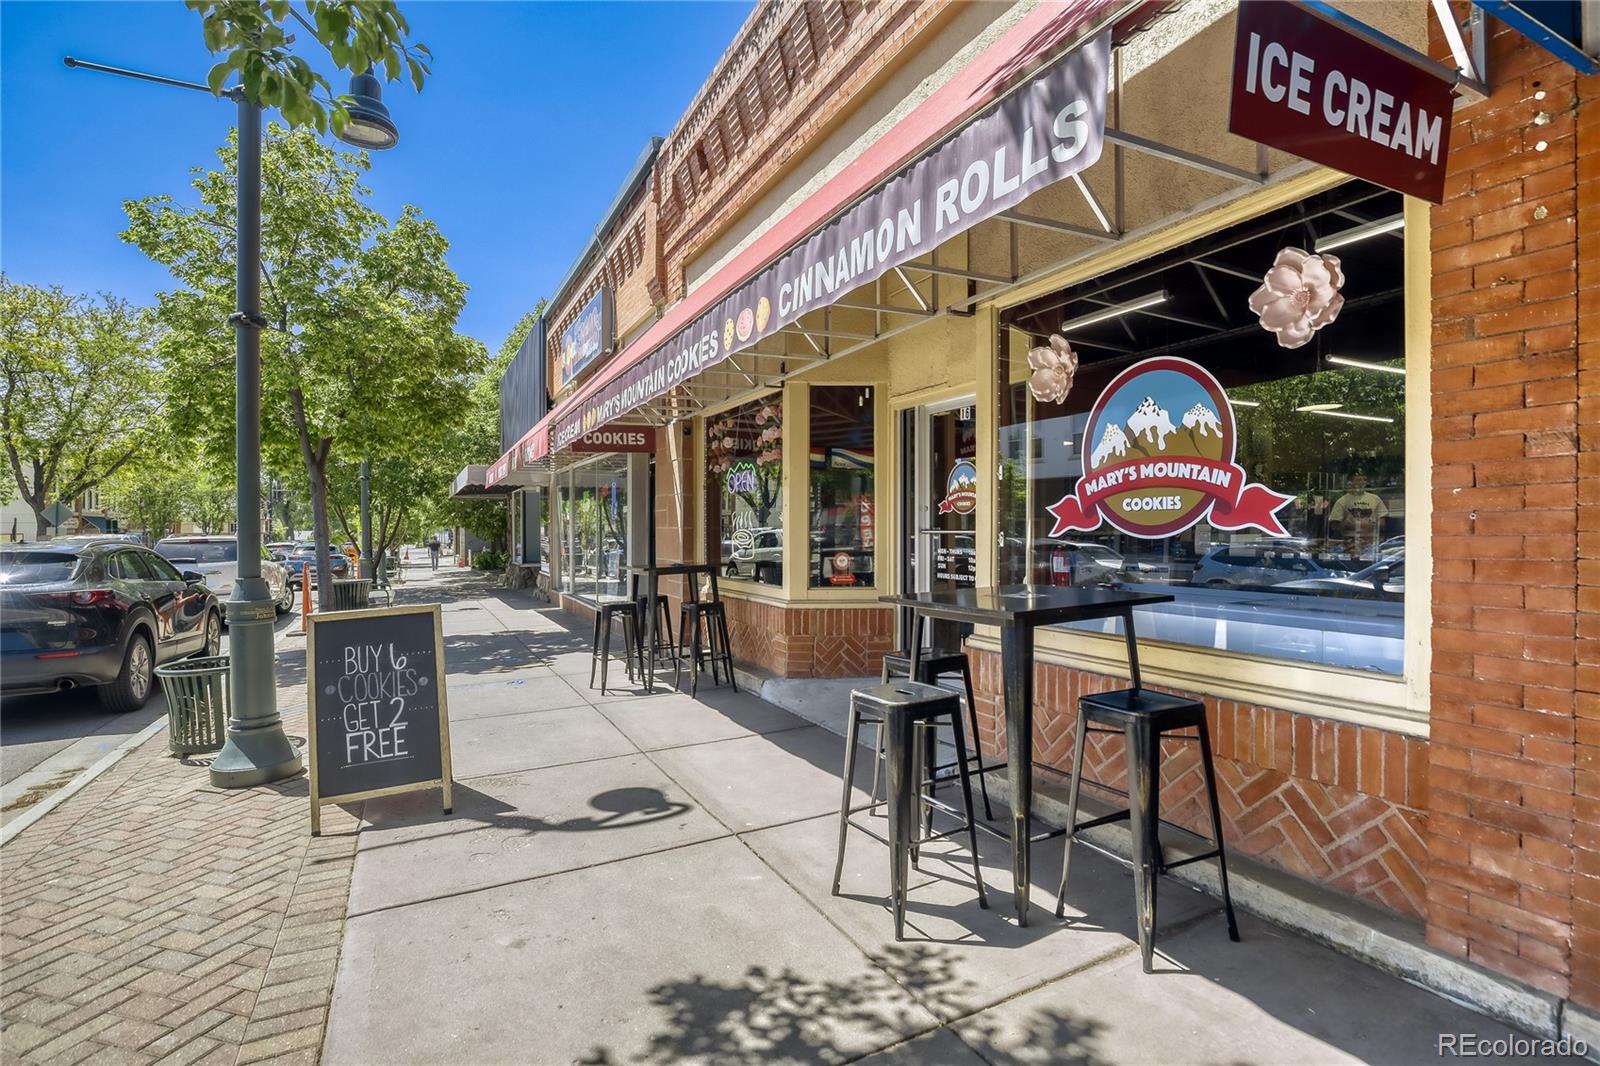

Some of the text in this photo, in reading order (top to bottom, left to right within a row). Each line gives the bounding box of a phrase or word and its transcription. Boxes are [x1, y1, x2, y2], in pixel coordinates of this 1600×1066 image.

[1246, 32, 1442, 165] ICE CREAM
[778, 100, 1089, 318] CINNAMON ROLLS
[596, 330, 719, 421] MARY'S MOUNTAIN COOKIES
[961, 407, 970, 420] 16
[583, 432, 646, 445] COOKIES
[728, 470, 754, 494] OPEN
[1085, 462, 1231, 496] MARY'S MOUNTAIN
[1122, 496, 1182, 511] COOKIES
[345, 643, 407, 675] BUY 6
[338, 668, 418, 703] COOKIES
[343, 697, 408, 732] GET 2
[346, 725, 408, 763] FREE
